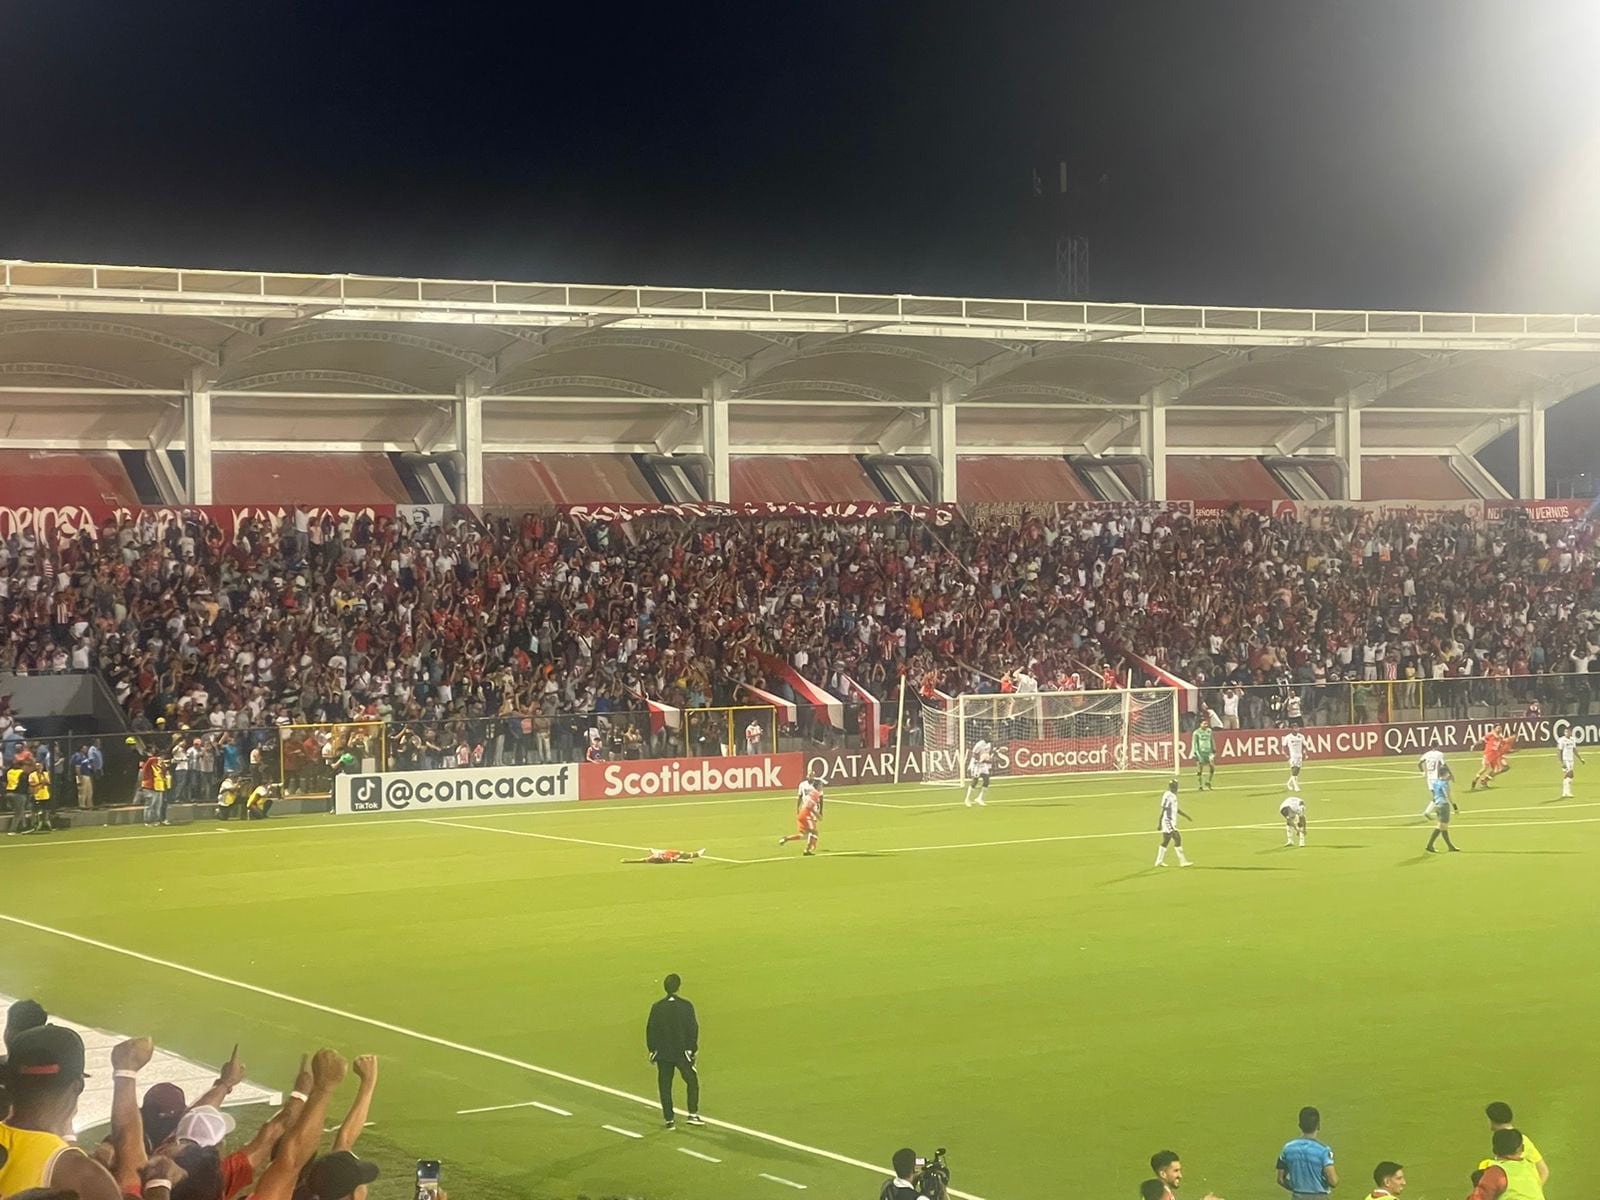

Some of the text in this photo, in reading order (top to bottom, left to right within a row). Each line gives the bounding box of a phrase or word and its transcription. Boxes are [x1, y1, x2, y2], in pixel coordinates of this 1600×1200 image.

[1014, 731, 1378, 768] Concacaf CENTRA AMERAN CUP
[1385, 725, 1457, 753] QATAR
[1553, 719, 1600, 744] Con
[604, 758, 784, 796] Scotiabank
[807, 747, 1009, 784] QATAR AIRWS
[354, 802, 378, 810] TikTok
[385, 766, 568, 809] @concacaf
